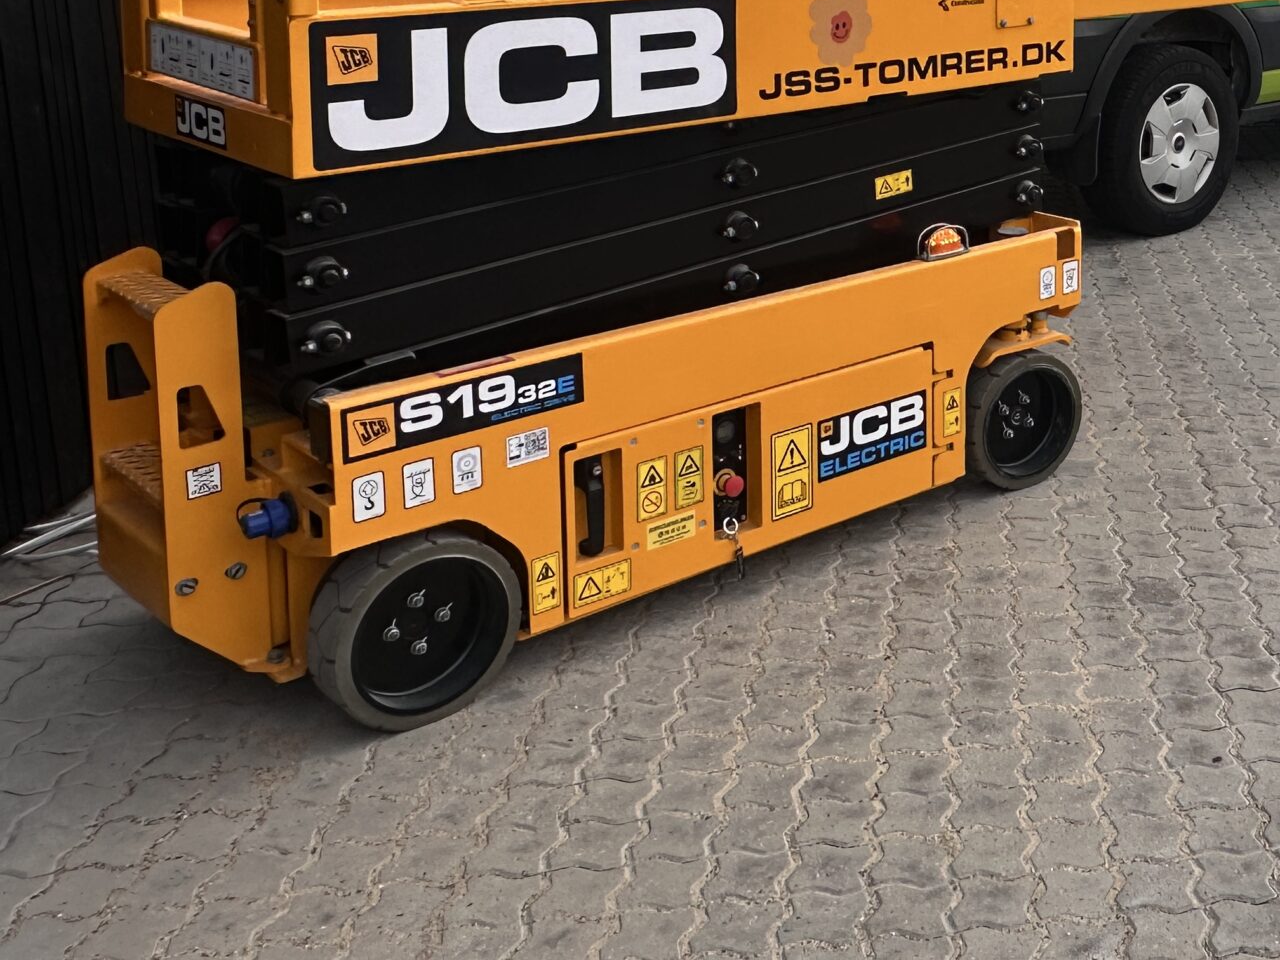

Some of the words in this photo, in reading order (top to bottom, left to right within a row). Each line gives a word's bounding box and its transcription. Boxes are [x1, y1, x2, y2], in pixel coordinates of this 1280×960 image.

[328, 7, 728, 152] JCB
[338, 48, 370, 71] JCB
[758, 40, 1067, 100] JSS-TOMRER.DK
[177, 100, 226, 145] JCB
[358, 419, 388, 443] JCB
[820, 394, 925, 456] JCB
[820, 430, 925, 478] ELECTRIC
